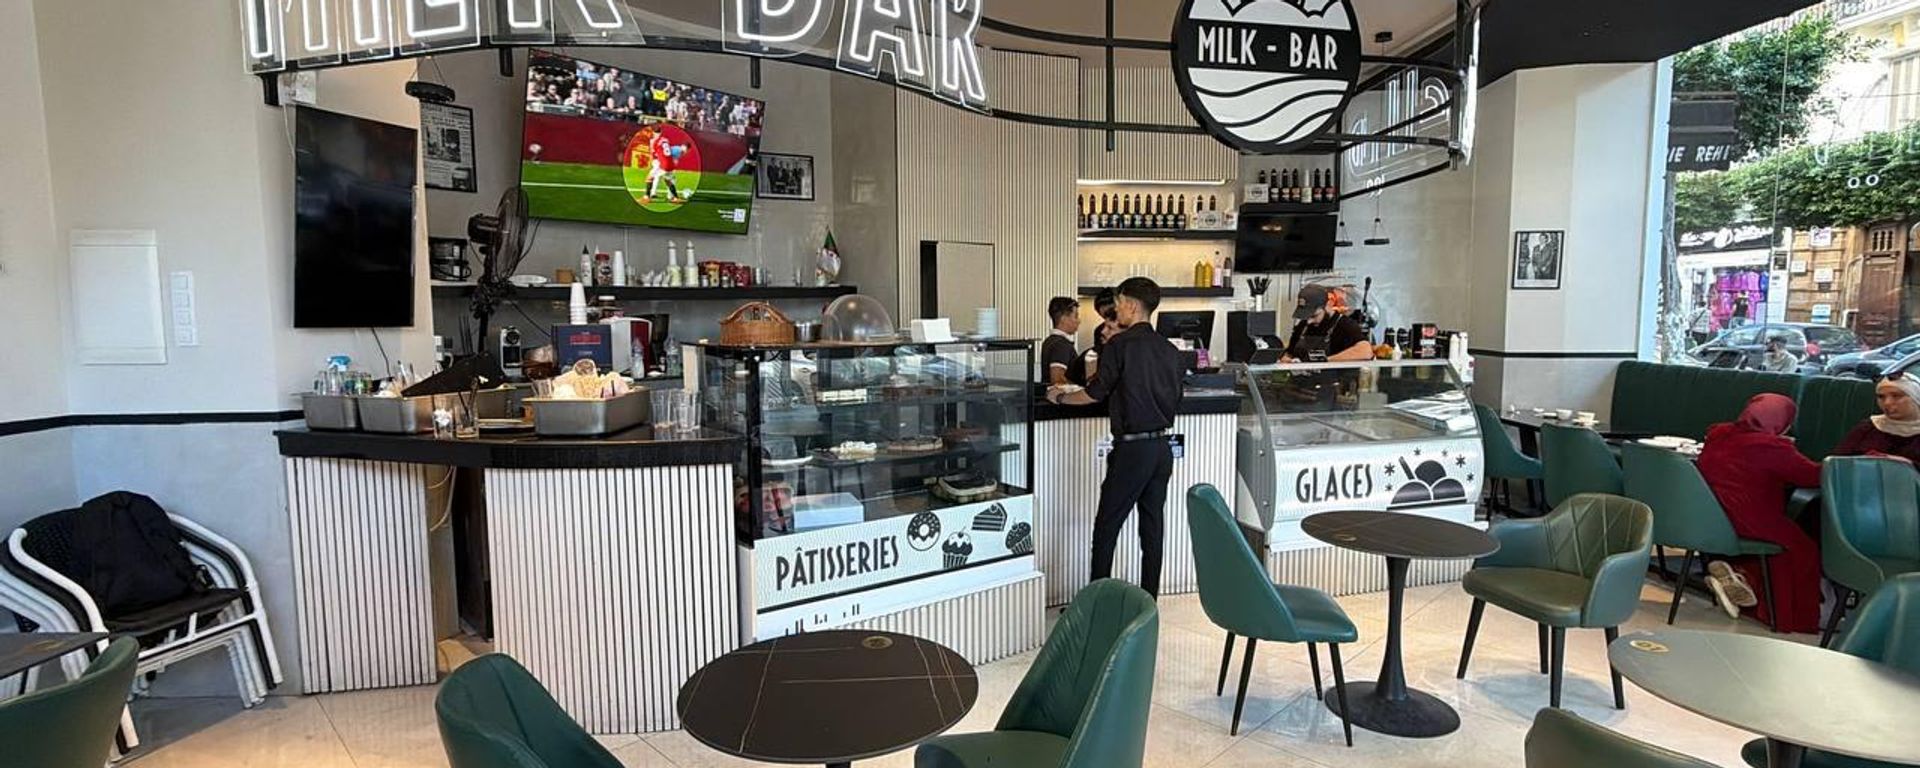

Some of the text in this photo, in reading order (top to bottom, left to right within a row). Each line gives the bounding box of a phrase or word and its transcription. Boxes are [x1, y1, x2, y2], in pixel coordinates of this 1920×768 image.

[1198, 25, 1257, 65] MILK
[1289, 31, 1338, 70] BAR
[1296, 464, 1373, 503] GLACES
[776, 535, 899, 591] PÂTISSERIES
